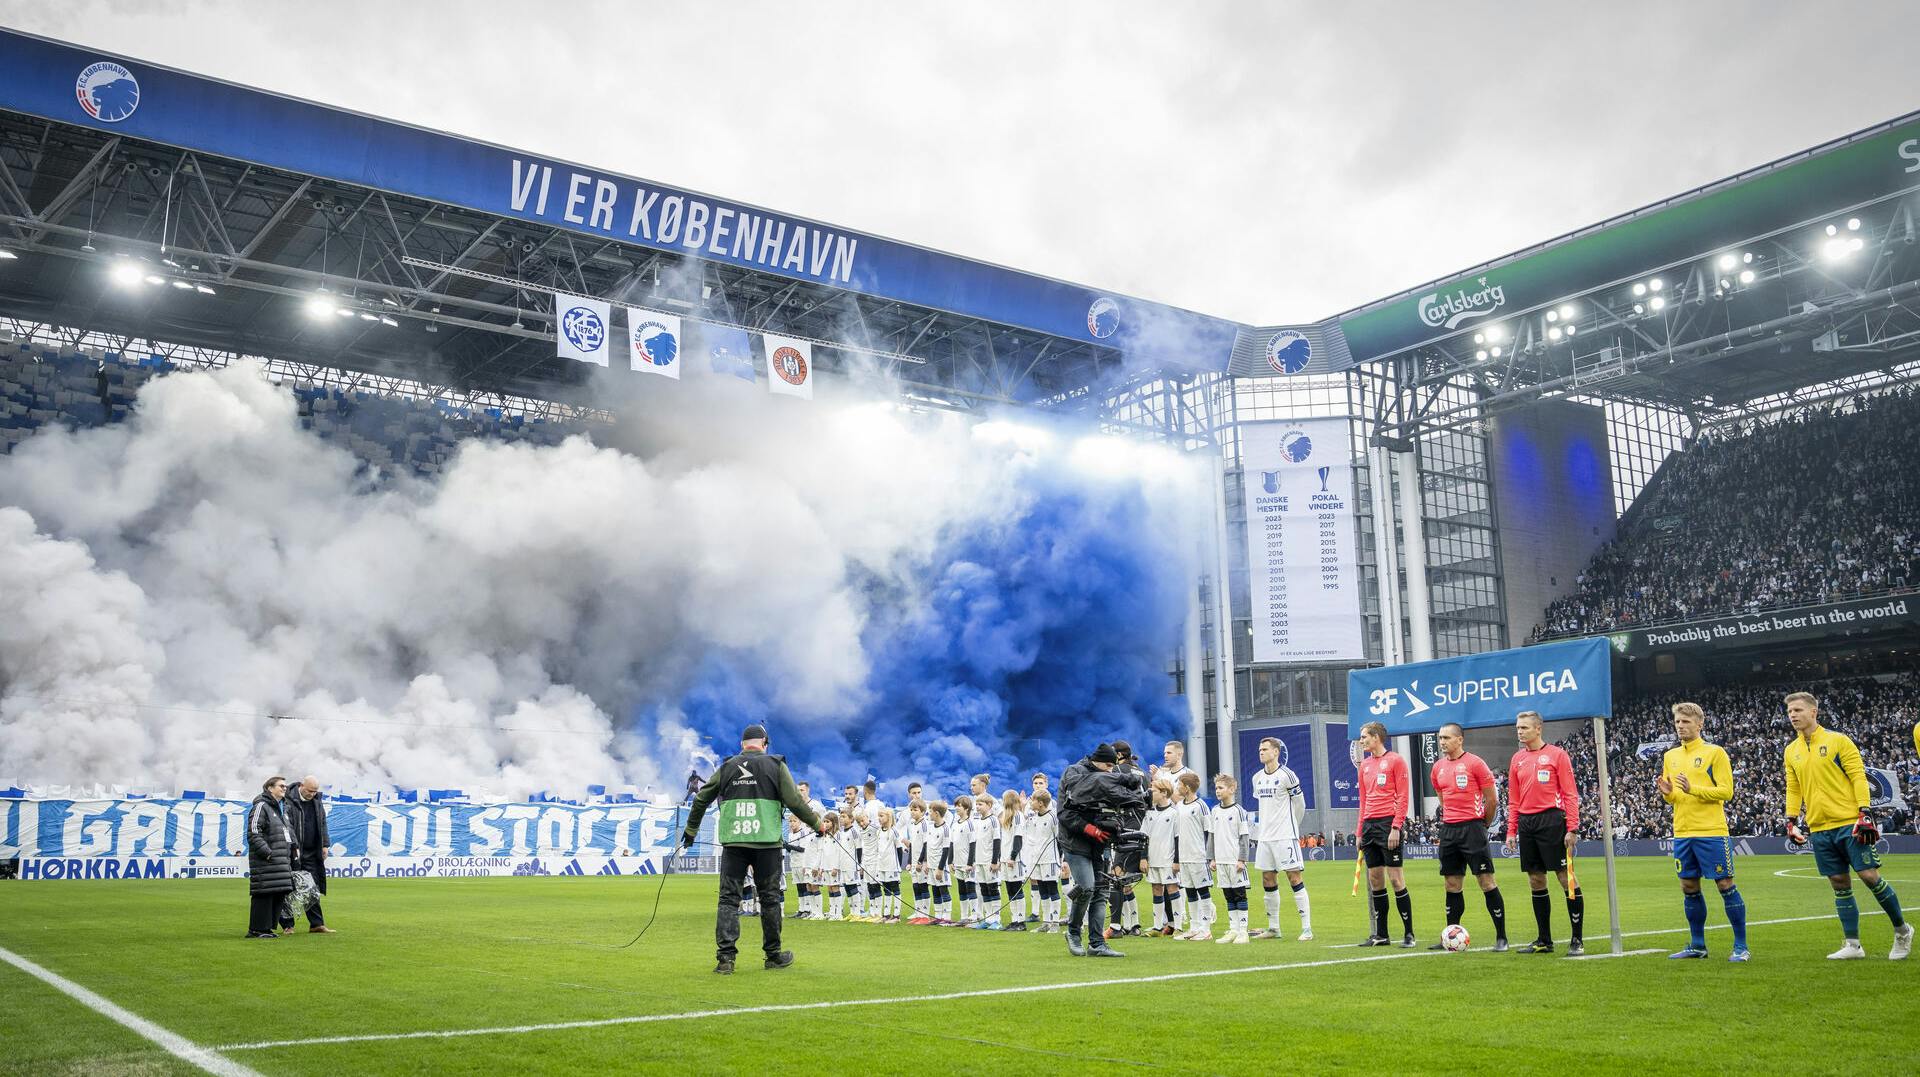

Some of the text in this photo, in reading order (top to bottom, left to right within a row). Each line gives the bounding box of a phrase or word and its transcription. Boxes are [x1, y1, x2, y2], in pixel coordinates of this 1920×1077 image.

[511, 160, 857, 283] VI ER KØBENHAVN
[1418, 285, 1505, 328] Carlsberg
[1256, 496, 1288, 504] DANSKE
[1309, 502, 1344, 510] VINDERE
[1647, 601, 1908, 645] Probably the best beer in the world
[1369, 669, 1578, 715] 3F SUPERLIGA
[735, 802, 757, 817] HB
[733, 819, 760, 835] 389
[1287, 847, 1293, 858] 7
[1407, 846, 1439, 855] UNIBET
[21, 858, 166, 880] HØRKRAM
[438, 857, 511, 867] BROLÆGNING
[670, 858, 711, 869] UNIBET
[325, 864, 364, 878] endo
[377, 864, 427, 878] Lendo
